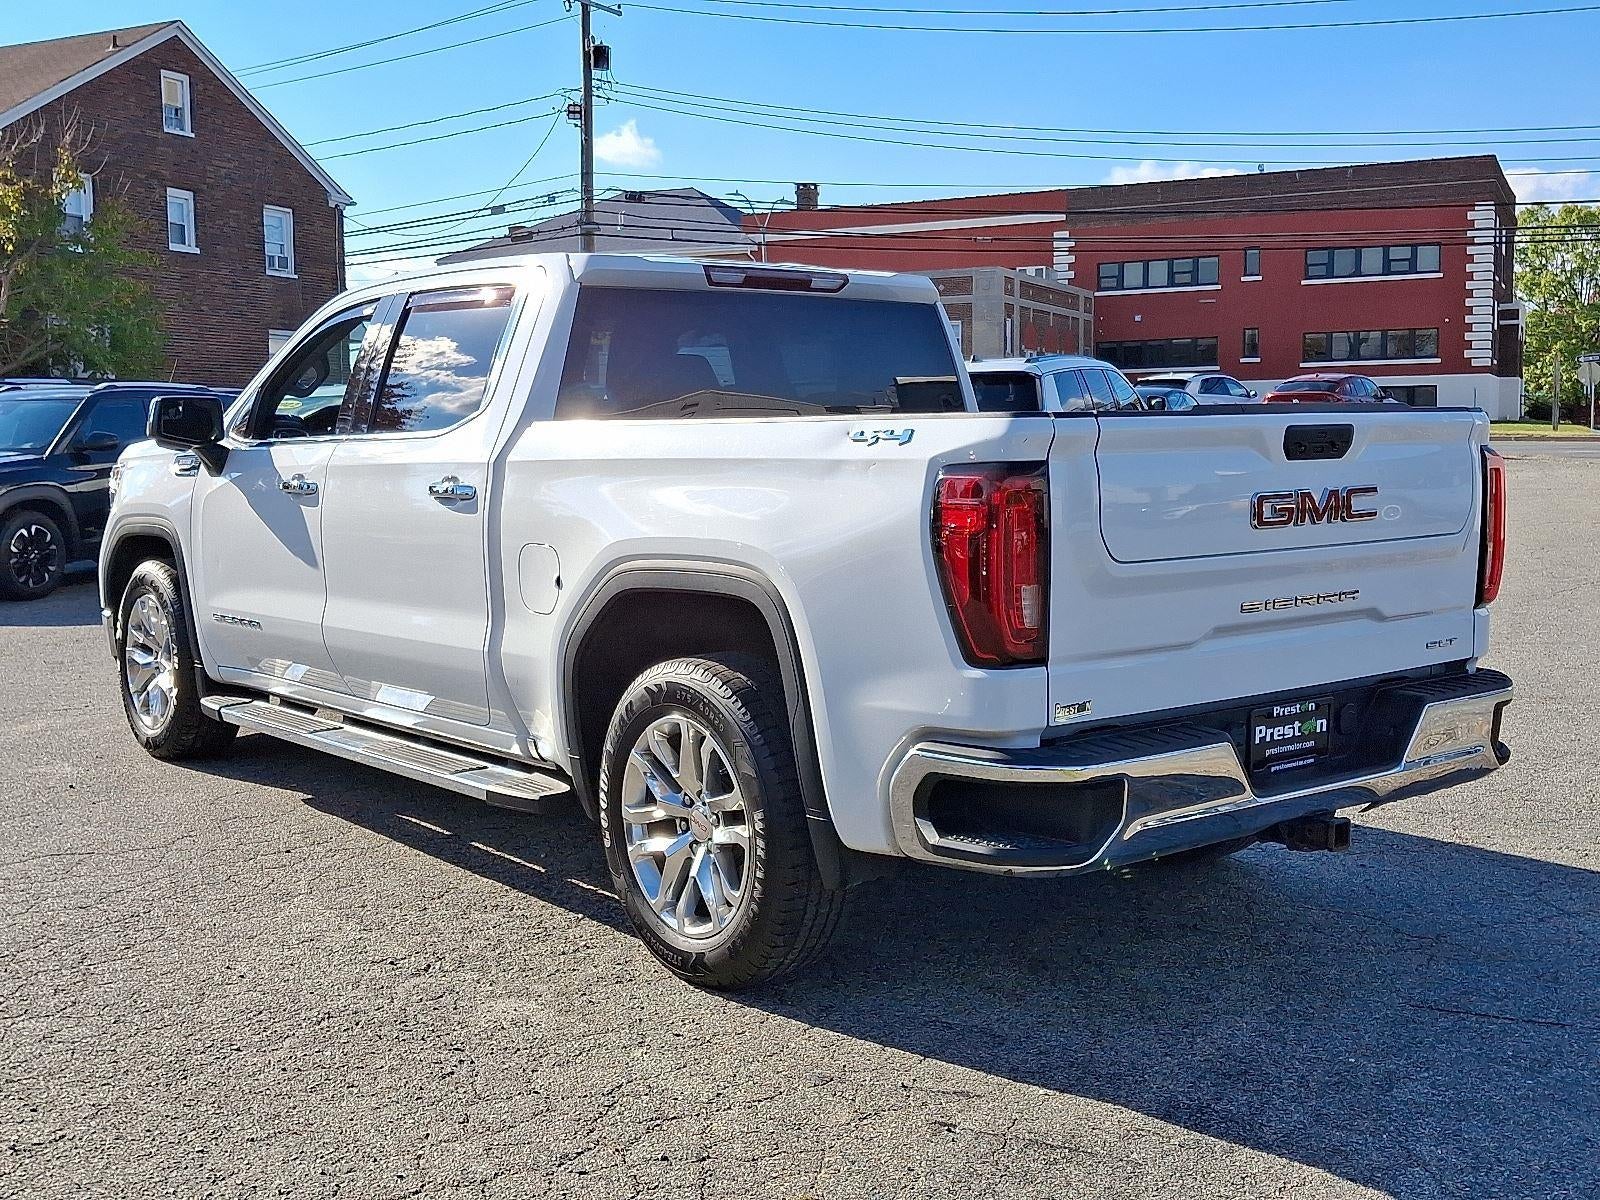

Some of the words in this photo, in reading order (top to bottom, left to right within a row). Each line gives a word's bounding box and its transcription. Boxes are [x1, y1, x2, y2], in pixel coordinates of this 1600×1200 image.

[1250, 484, 1379, 530] GMC
[1239, 589, 1360, 614] SIERRA
[212, 613, 264, 631] SIERRA
[1265, 740, 1315, 757] prestonmotor.com
